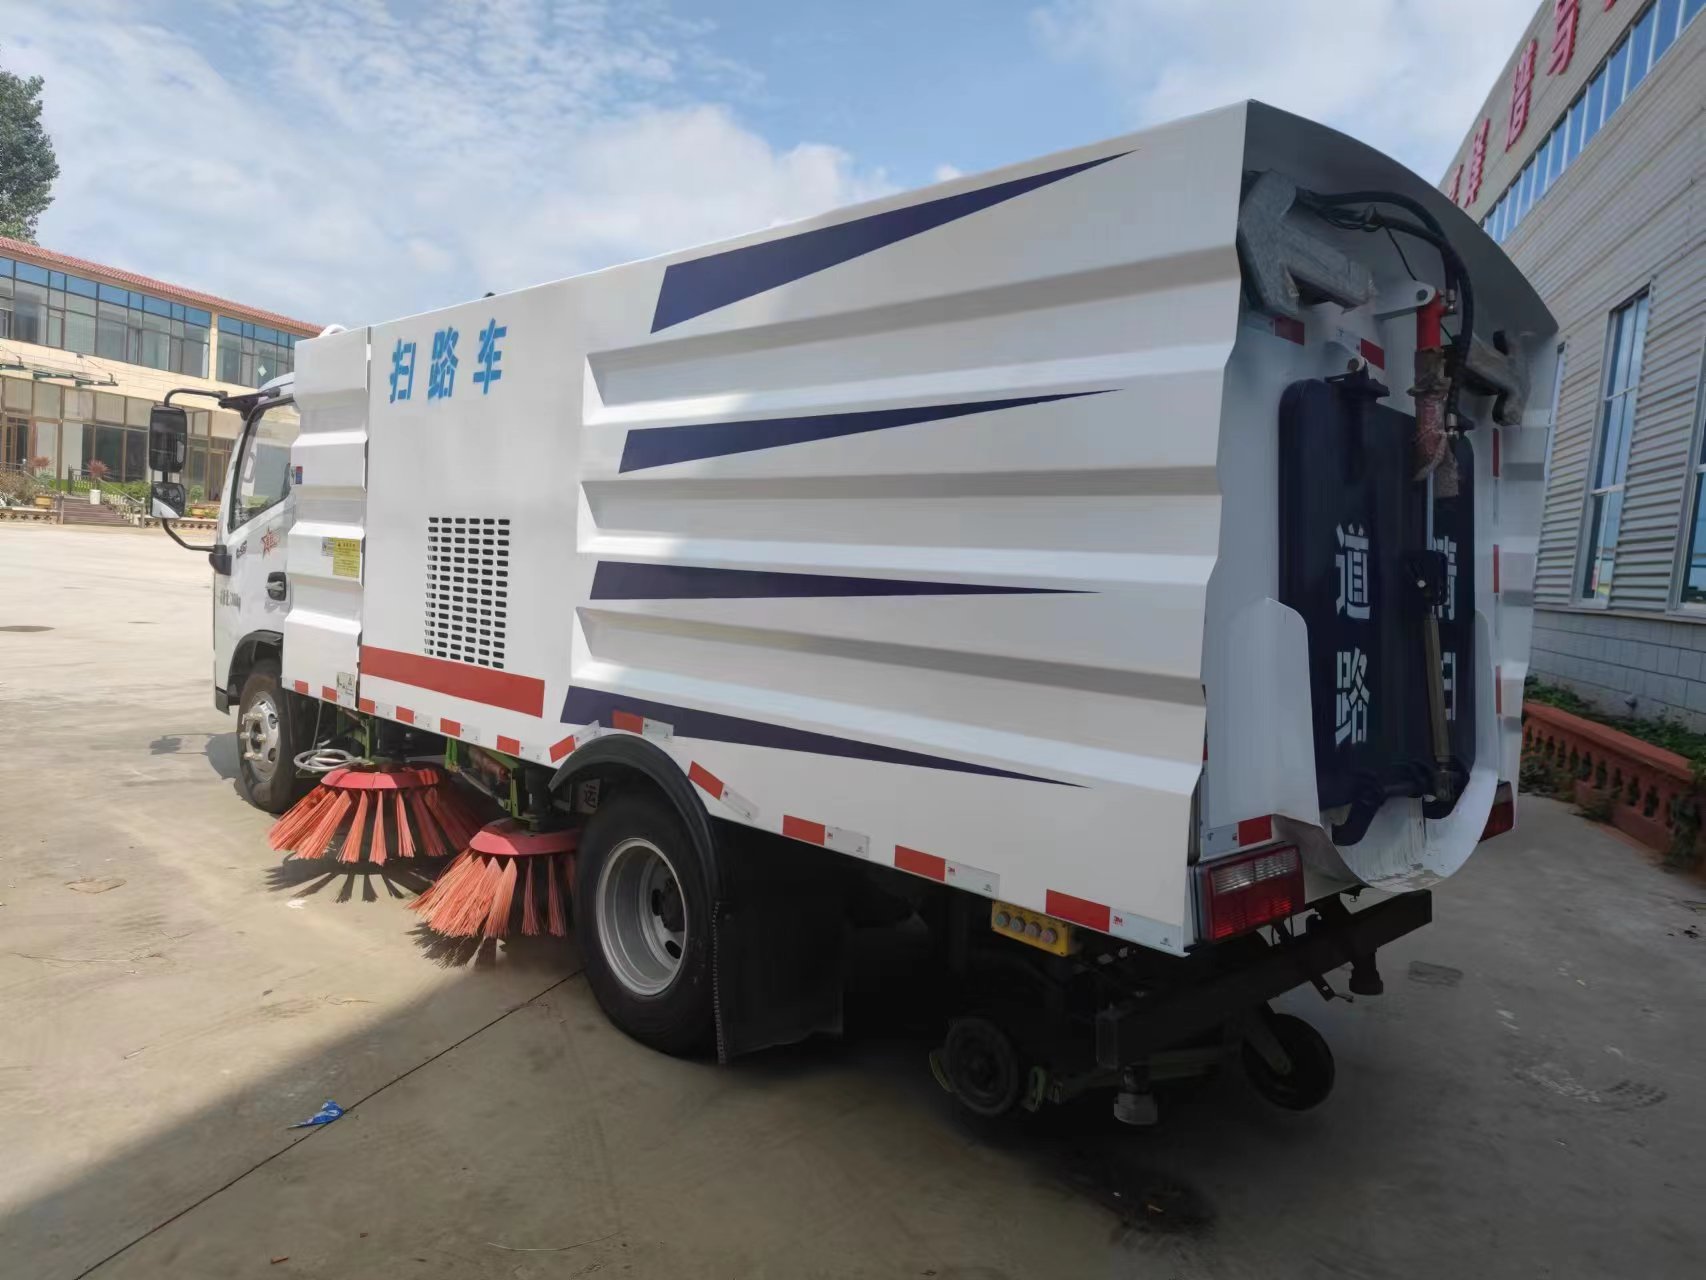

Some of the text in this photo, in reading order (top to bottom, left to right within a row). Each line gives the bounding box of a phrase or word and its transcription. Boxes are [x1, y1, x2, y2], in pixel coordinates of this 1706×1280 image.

[389, 317, 507, 404] 扫路车
[1335, 522, 1371, 747] 道路
